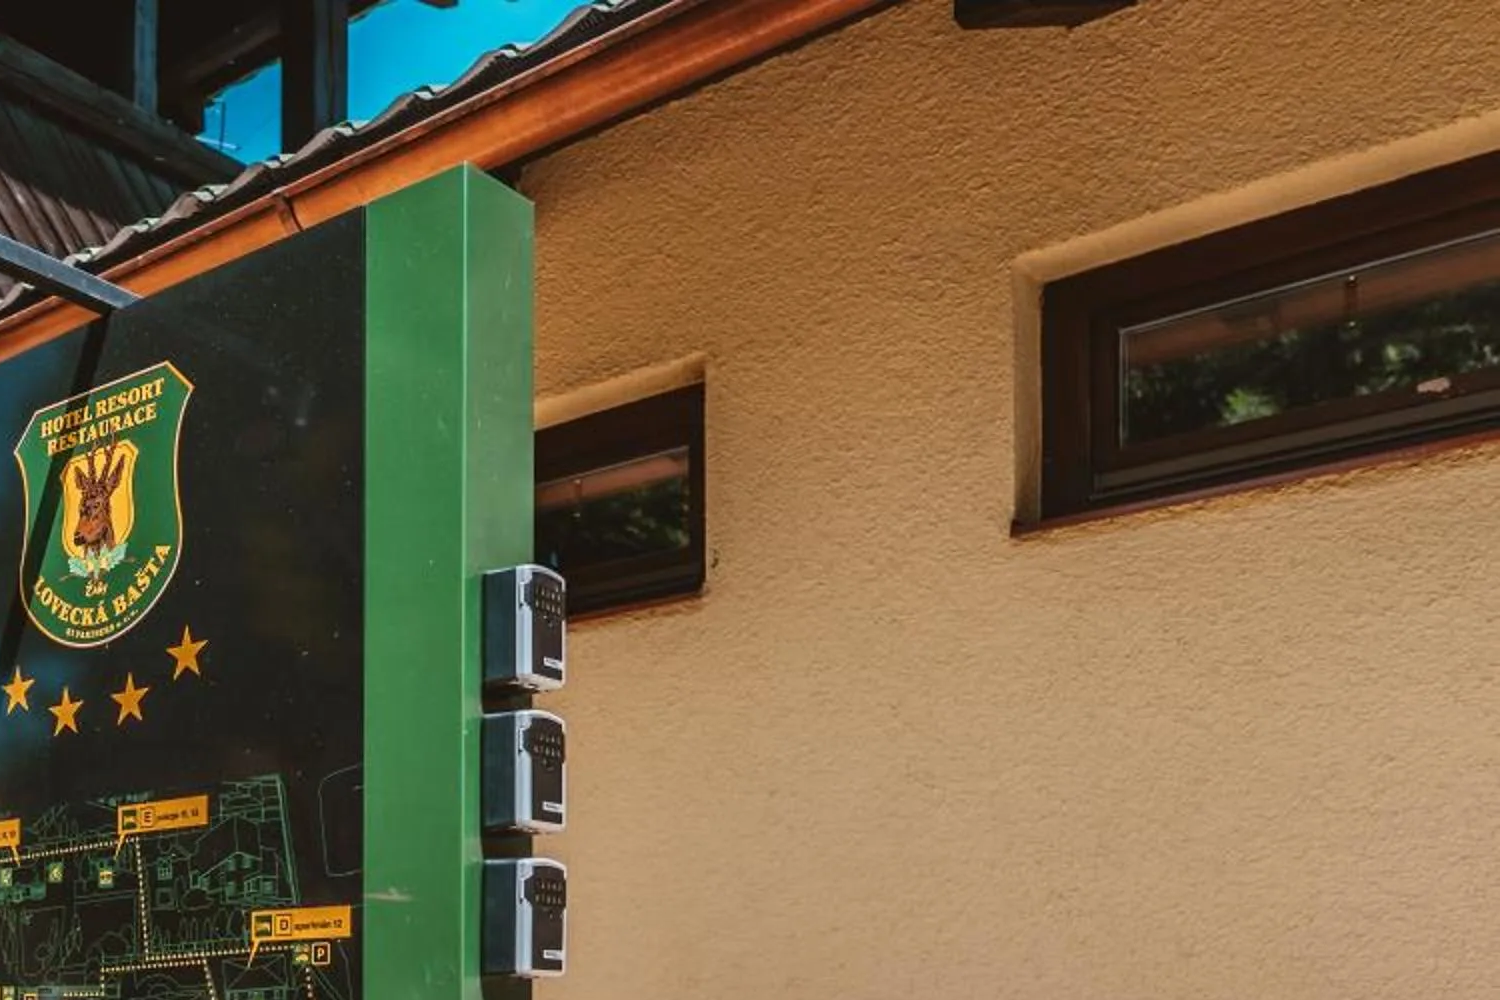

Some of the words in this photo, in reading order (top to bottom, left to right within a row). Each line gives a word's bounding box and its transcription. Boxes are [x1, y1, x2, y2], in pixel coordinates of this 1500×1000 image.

[40, 404, 94, 440] HOTEL
[95, 376, 166, 419] RESORT
[47, 401, 158, 456] RESTAURACE
[34, 575, 110, 626] LOVECKÁ
[112, 545, 171, 617] BAŠTA
